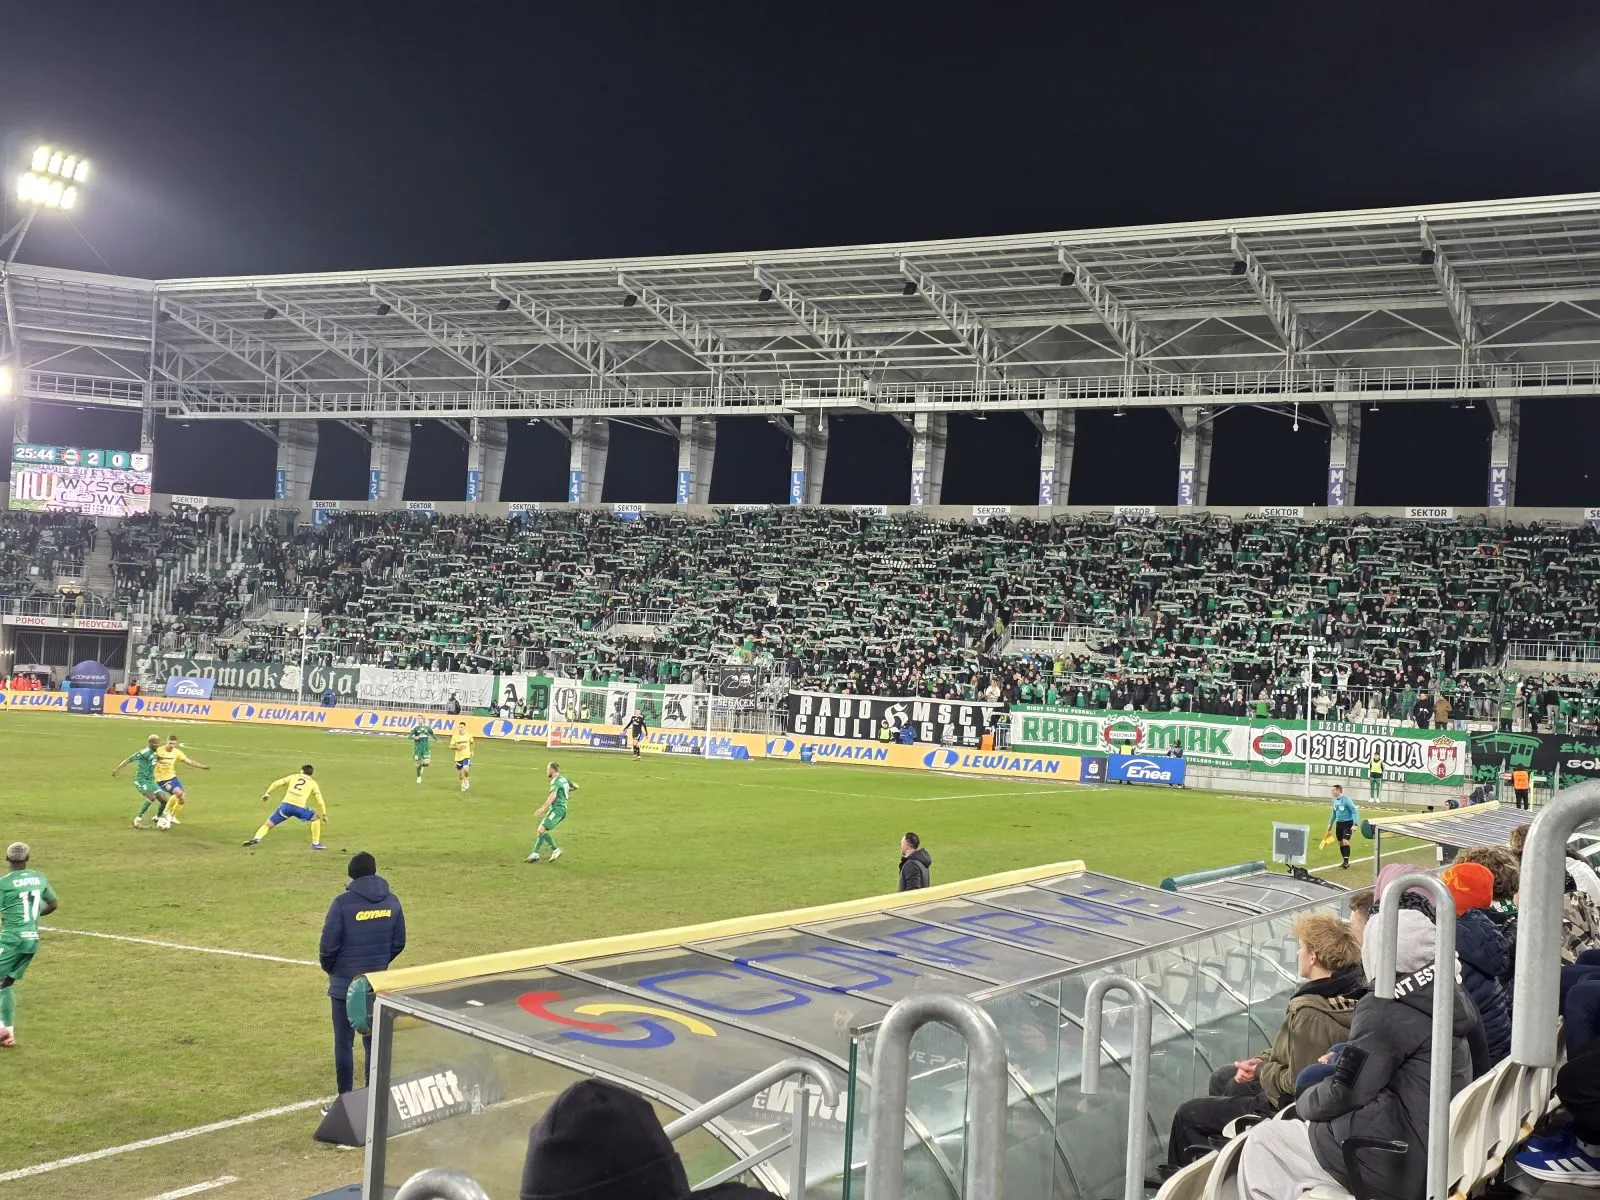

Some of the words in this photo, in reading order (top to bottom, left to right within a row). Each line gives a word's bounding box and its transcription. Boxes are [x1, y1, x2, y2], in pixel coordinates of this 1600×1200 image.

[16, 447, 55, 461] 25:44
[87, 452, 98, 464] 2
[617, 504, 642, 512] SEKTOR
[977, 507, 1006, 515] SEKTOR
[1264, 508, 1299, 517] SEKTOR
[1411, 508, 1447, 517] SEKTOR
[16, 616, 46, 625] POMOC
[78, 620, 123, 629] MEDYCZNA
[177, 685, 205, 698] Enea
[11, 694, 67, 708] LEWIA
[146, 700, 212, 716] LEWIATAN
[257, 707, 327, 723] LEWIATAN
[381, 715, 455, 731] LEWITAN
[1318, 721, 1356, 733] DZIECI
[1362, 724, 1395, 737] ULICY
[1295, 733, 1424, 769] OSIEDLOWA
[962, 754, 1060, 774] LEWIATAN
[1126, 765, 1172, 781] Enea
[293, 778, 306, 791] 2
[19, 889, 41, 923] 11
[637, 888, 1186, 1016] CONFIRME
[399, 1069, 465, 1118] Witt
